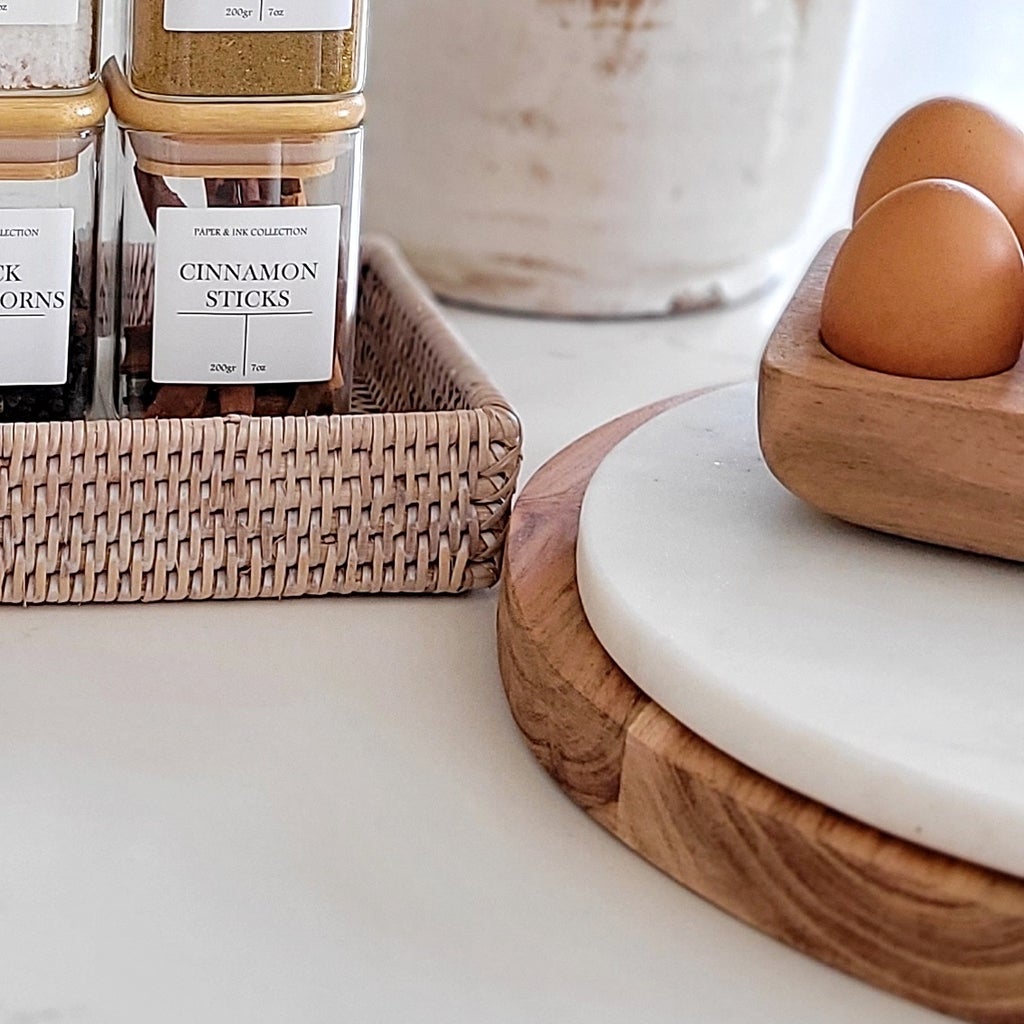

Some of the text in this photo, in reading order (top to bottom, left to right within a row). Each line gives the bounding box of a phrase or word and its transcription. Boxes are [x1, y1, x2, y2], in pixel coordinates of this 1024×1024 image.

[225, 7, 254, 19] 200gr
[268, 8, 285, 17] 7oz
[193, 227, 309, 237] PAPER & INK COLLECTION
[180, 263, 319, 281] CINNAMON
[206, 290, 290, 308] STICKS
[209, 363, 237, 375] 200gr
[250, 363, 267, 373] 7oz
